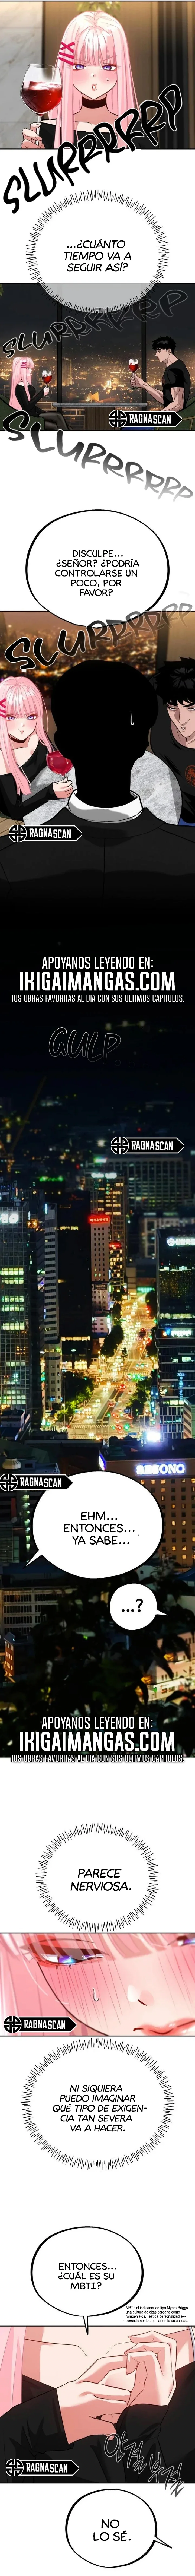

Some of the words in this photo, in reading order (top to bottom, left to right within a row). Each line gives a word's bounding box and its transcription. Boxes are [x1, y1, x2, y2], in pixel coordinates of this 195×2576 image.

[67, 239, 125, 248] ...¿CUÁNTO
[64, 252, 103, 260] TIEMPO
[108, 252, 120, 260] VA
[124, 252, 131, 260] A
[67, 263, 102, 272] SEGUIR
[105, 262, 128, 271] ASÍ?
[101, 559, 139, 567] ¿PODRÍA
[81, 1512, 117, 1520] EHM...
[64, 1524, 135, 1532] ENTONCES...
[72, 1536, 86, 1545] YA
[90, 1536, 129, 1545] SABE...
[122, 1599, 143, 1612] ...?
[78, 1869, 121, 1878] PARECE
[71, 1882, 131, 1891] NERVIOSA.
[53, 2104, 72, 2112] QUÉ
[58, 2271, 86, 2280] ¿CUÁL
[102, 2519, 119, 2528] NO
[93, 2532, 109, 2541] LO
[113, 2531, 131, 2541] SÉ.
